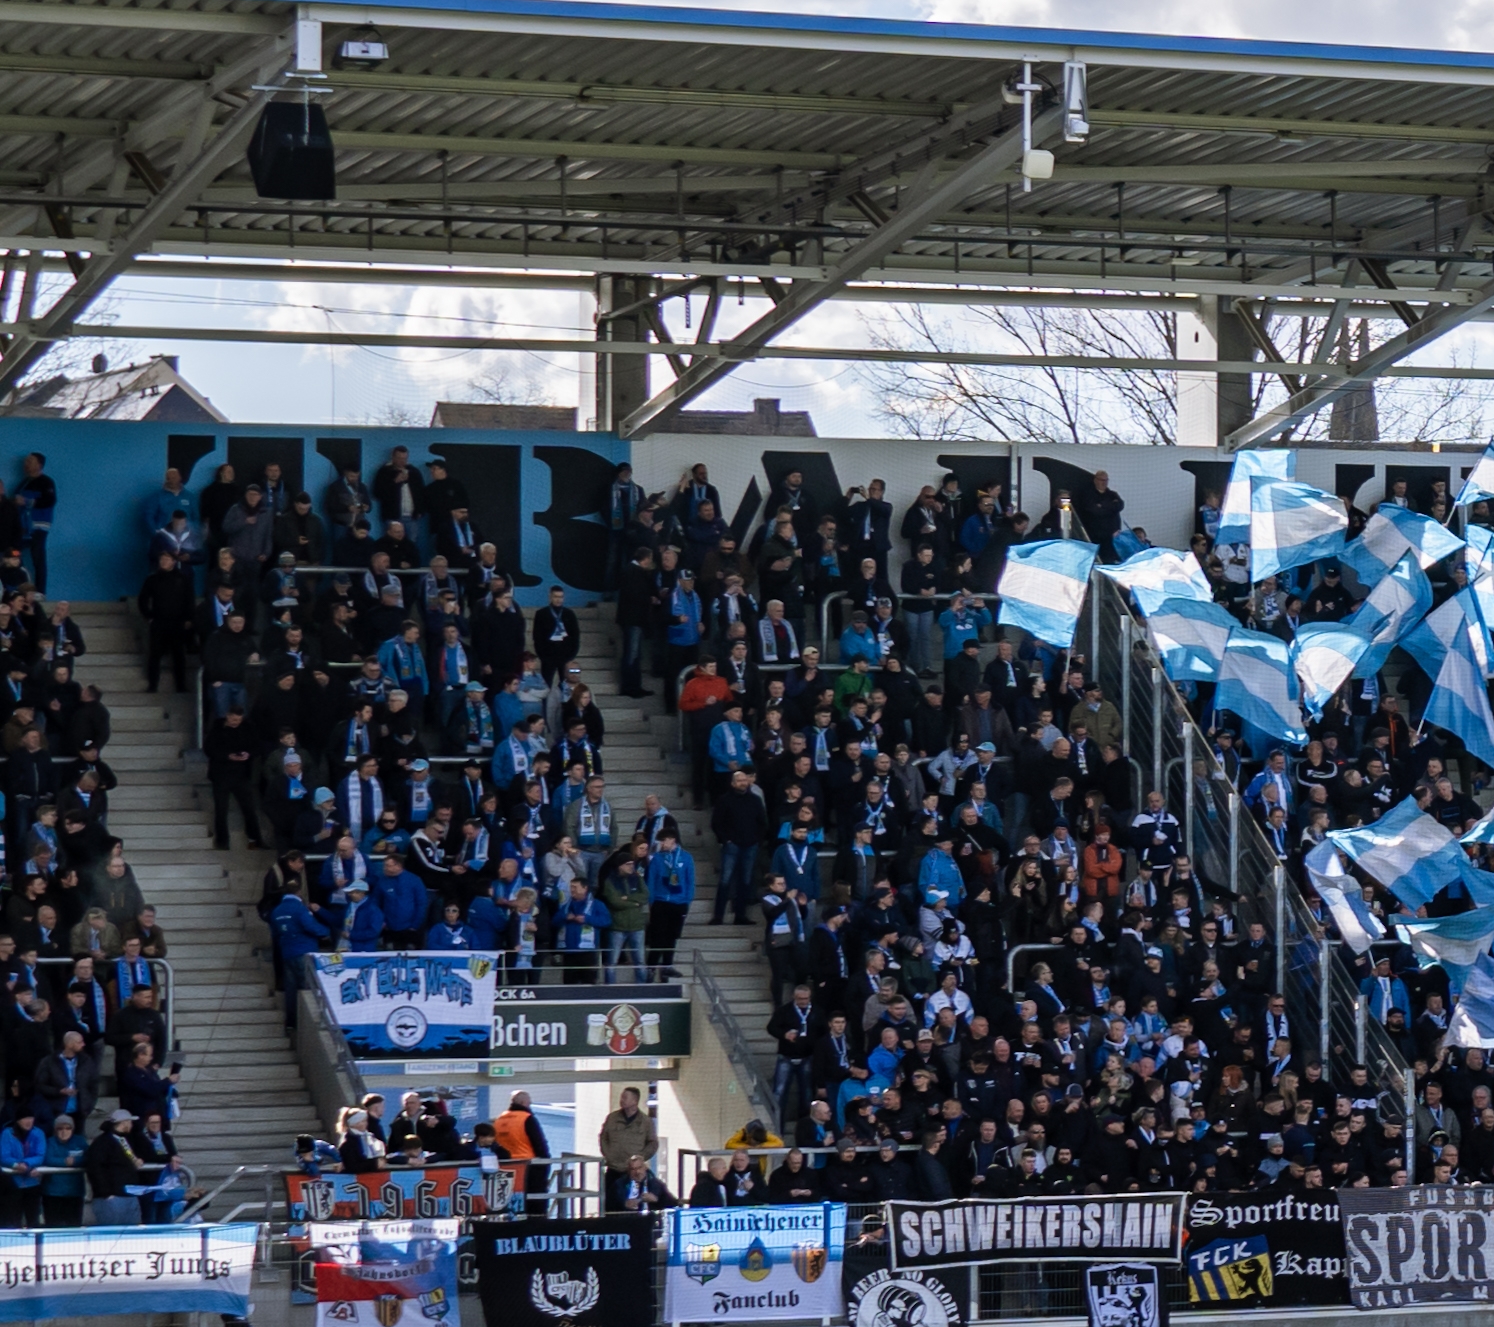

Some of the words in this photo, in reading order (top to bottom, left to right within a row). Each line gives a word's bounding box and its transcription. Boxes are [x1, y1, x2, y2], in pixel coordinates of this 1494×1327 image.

[344, 1177, 474, 1219] 1966
[1189, 1194, 1341, 1229] Sportfreu
[692, 1211, 823, 1233] Hainichener
[900, 1202, 1174, 1258] SCHWEIKERSHAIN
[496, 1230, 632, 1256] BLAUBLÜTER
[0, 1254, 136, 1289] hemnitzer
[145, 1250, 231, 1282] Jungs
[1273, 1250, 1350, 1279] Kap
[712, 1290, 801, 1315] Fanclub
[852, 1268, 891, 1299] BEER
[924, 1278, 962, 1324] GLORY
[1360, 1287, 1420, 1308] KARL
